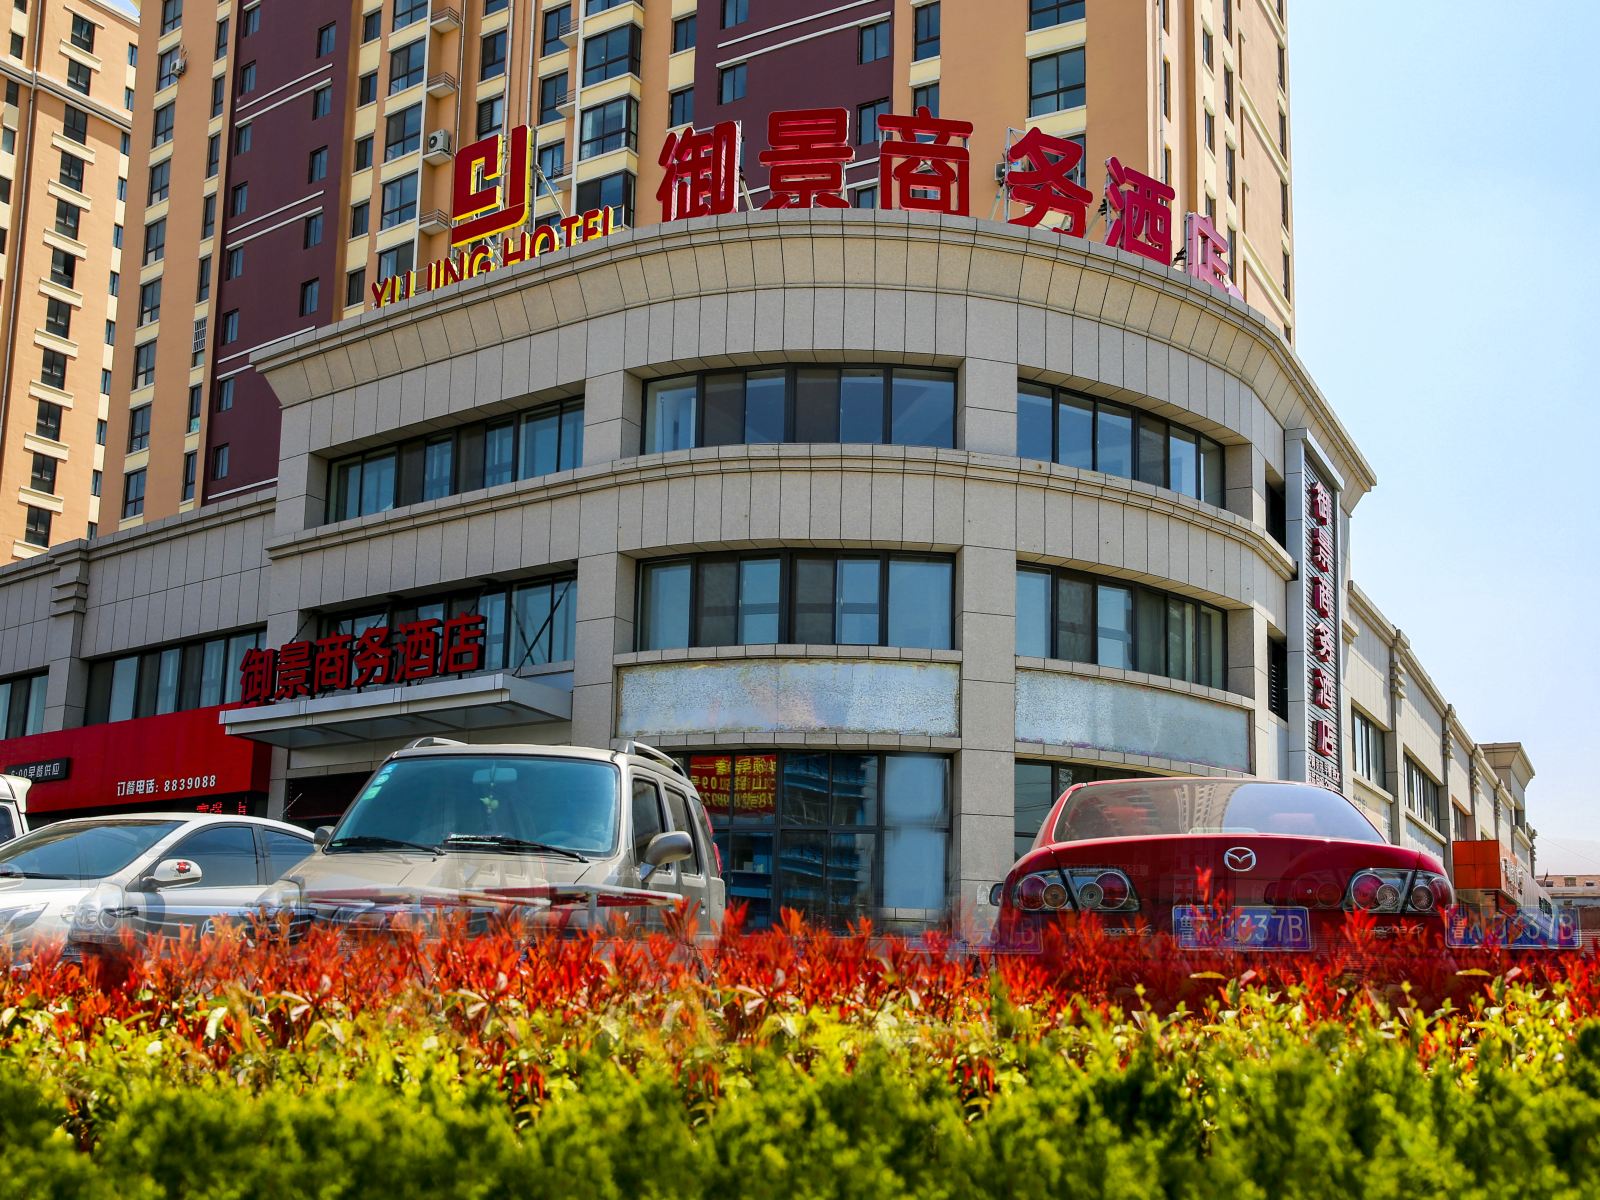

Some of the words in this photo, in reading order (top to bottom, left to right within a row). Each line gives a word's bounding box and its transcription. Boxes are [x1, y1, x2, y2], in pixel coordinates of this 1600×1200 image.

[657, 106, 1243, 301] 御景商务酒店
[239, 612, 487, 702] 御景商务酒店
[163, 774, 217, 793] 8839088
